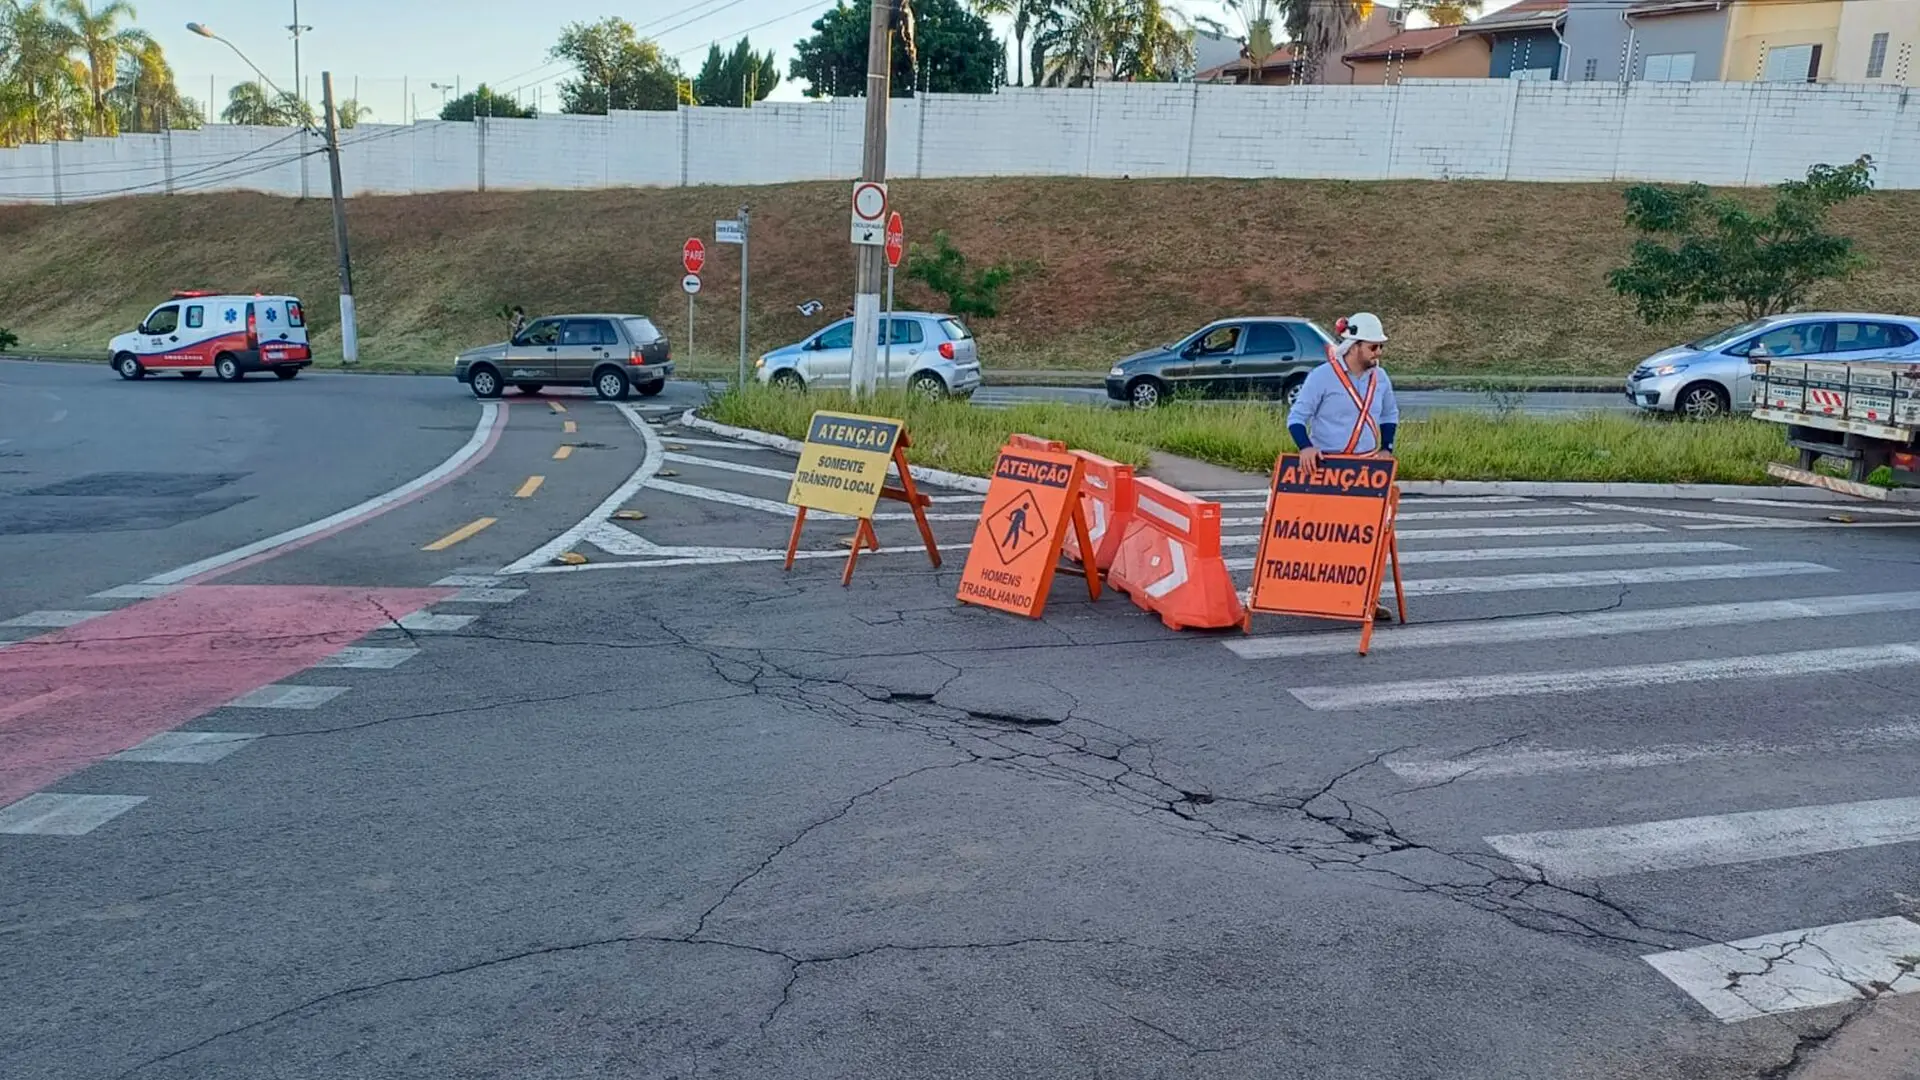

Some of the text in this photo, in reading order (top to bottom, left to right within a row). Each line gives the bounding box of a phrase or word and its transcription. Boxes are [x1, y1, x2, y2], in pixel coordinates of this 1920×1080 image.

[684, 249, 704, 261] PARE
[818, 423, 888, 448] ATENÇÃO
[817, 455, 866, 474] SOMENTE
[998, 458, 1069, 484] ATENÇÃO
[797, 469, 876, 495] TRÂNSITO LOCAL
[1281, 465, 1388, 492] ATENÇÃO
[1273, 516, 1374, 544] MÁQUINAS
[981, 568, 1022, 588] HOMENS
[1266, 559, 1367, 586] TRABALHANDO
[962, 581, 1032, 609] TRABALHANDO
